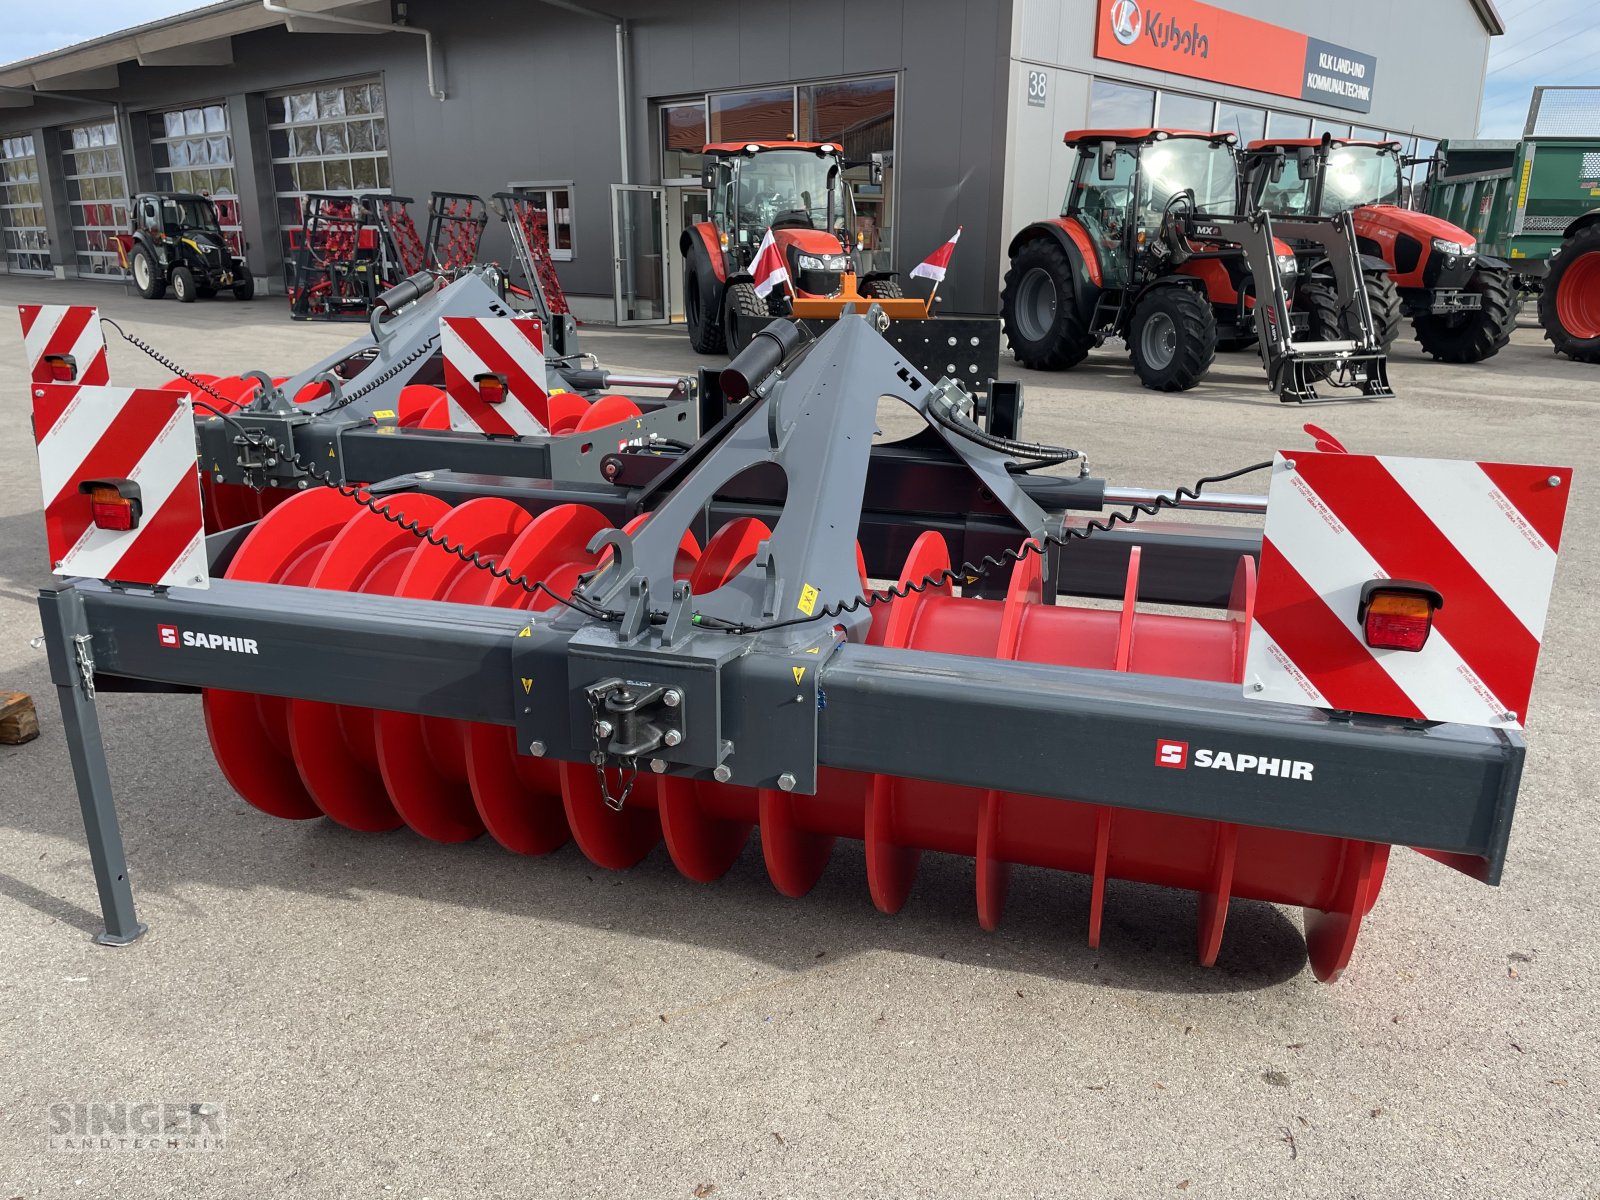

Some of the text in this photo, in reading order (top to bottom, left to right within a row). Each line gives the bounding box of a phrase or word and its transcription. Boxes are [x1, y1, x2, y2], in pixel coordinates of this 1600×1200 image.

[1145, 10, 1209, 58] Kubota
[1318, 52, 1365, 78] KLK LAND-UND
[1029, 71, 1047, 97] 38
[1307, 72, 1370, 101] KOMMUNALTECHNIK
[182, 631, 259, 655] SAPHIR
[1194, 749, 1315, 781] SAPHIR
